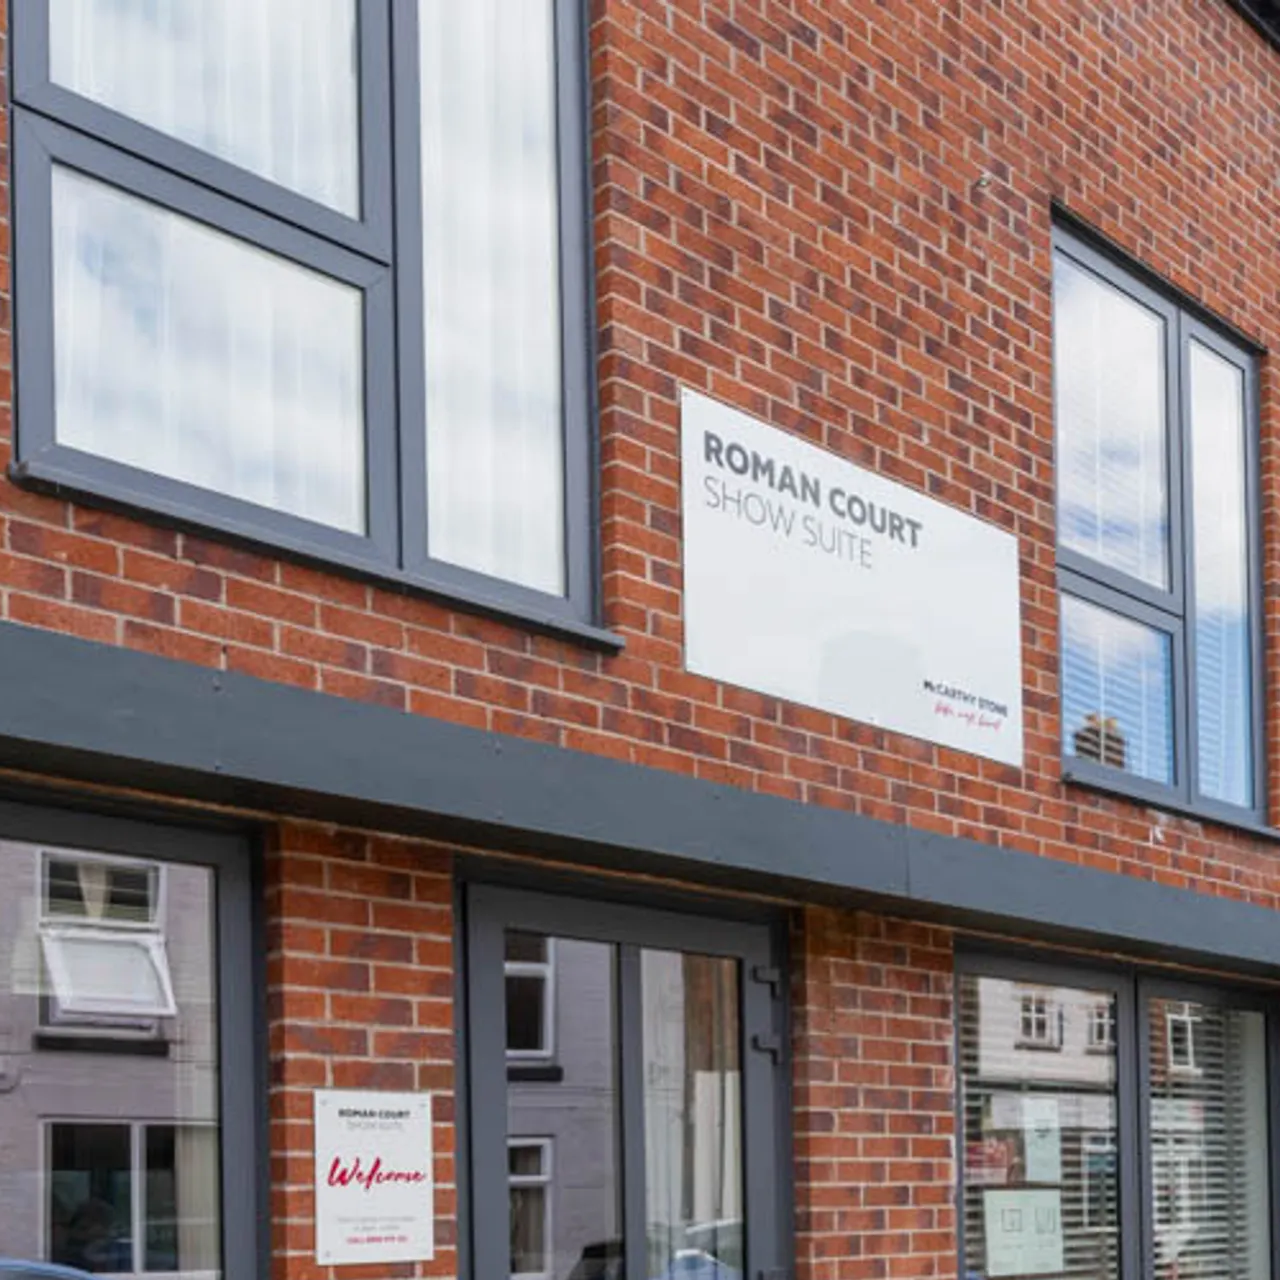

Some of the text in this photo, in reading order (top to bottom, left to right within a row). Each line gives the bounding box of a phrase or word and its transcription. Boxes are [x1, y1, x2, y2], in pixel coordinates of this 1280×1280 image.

[704, 430, 923, 548] ROMAN COURT
[704, 475, 872, 569] SHOW SUITE
[327, 1156, 425, 1191] Welcome
